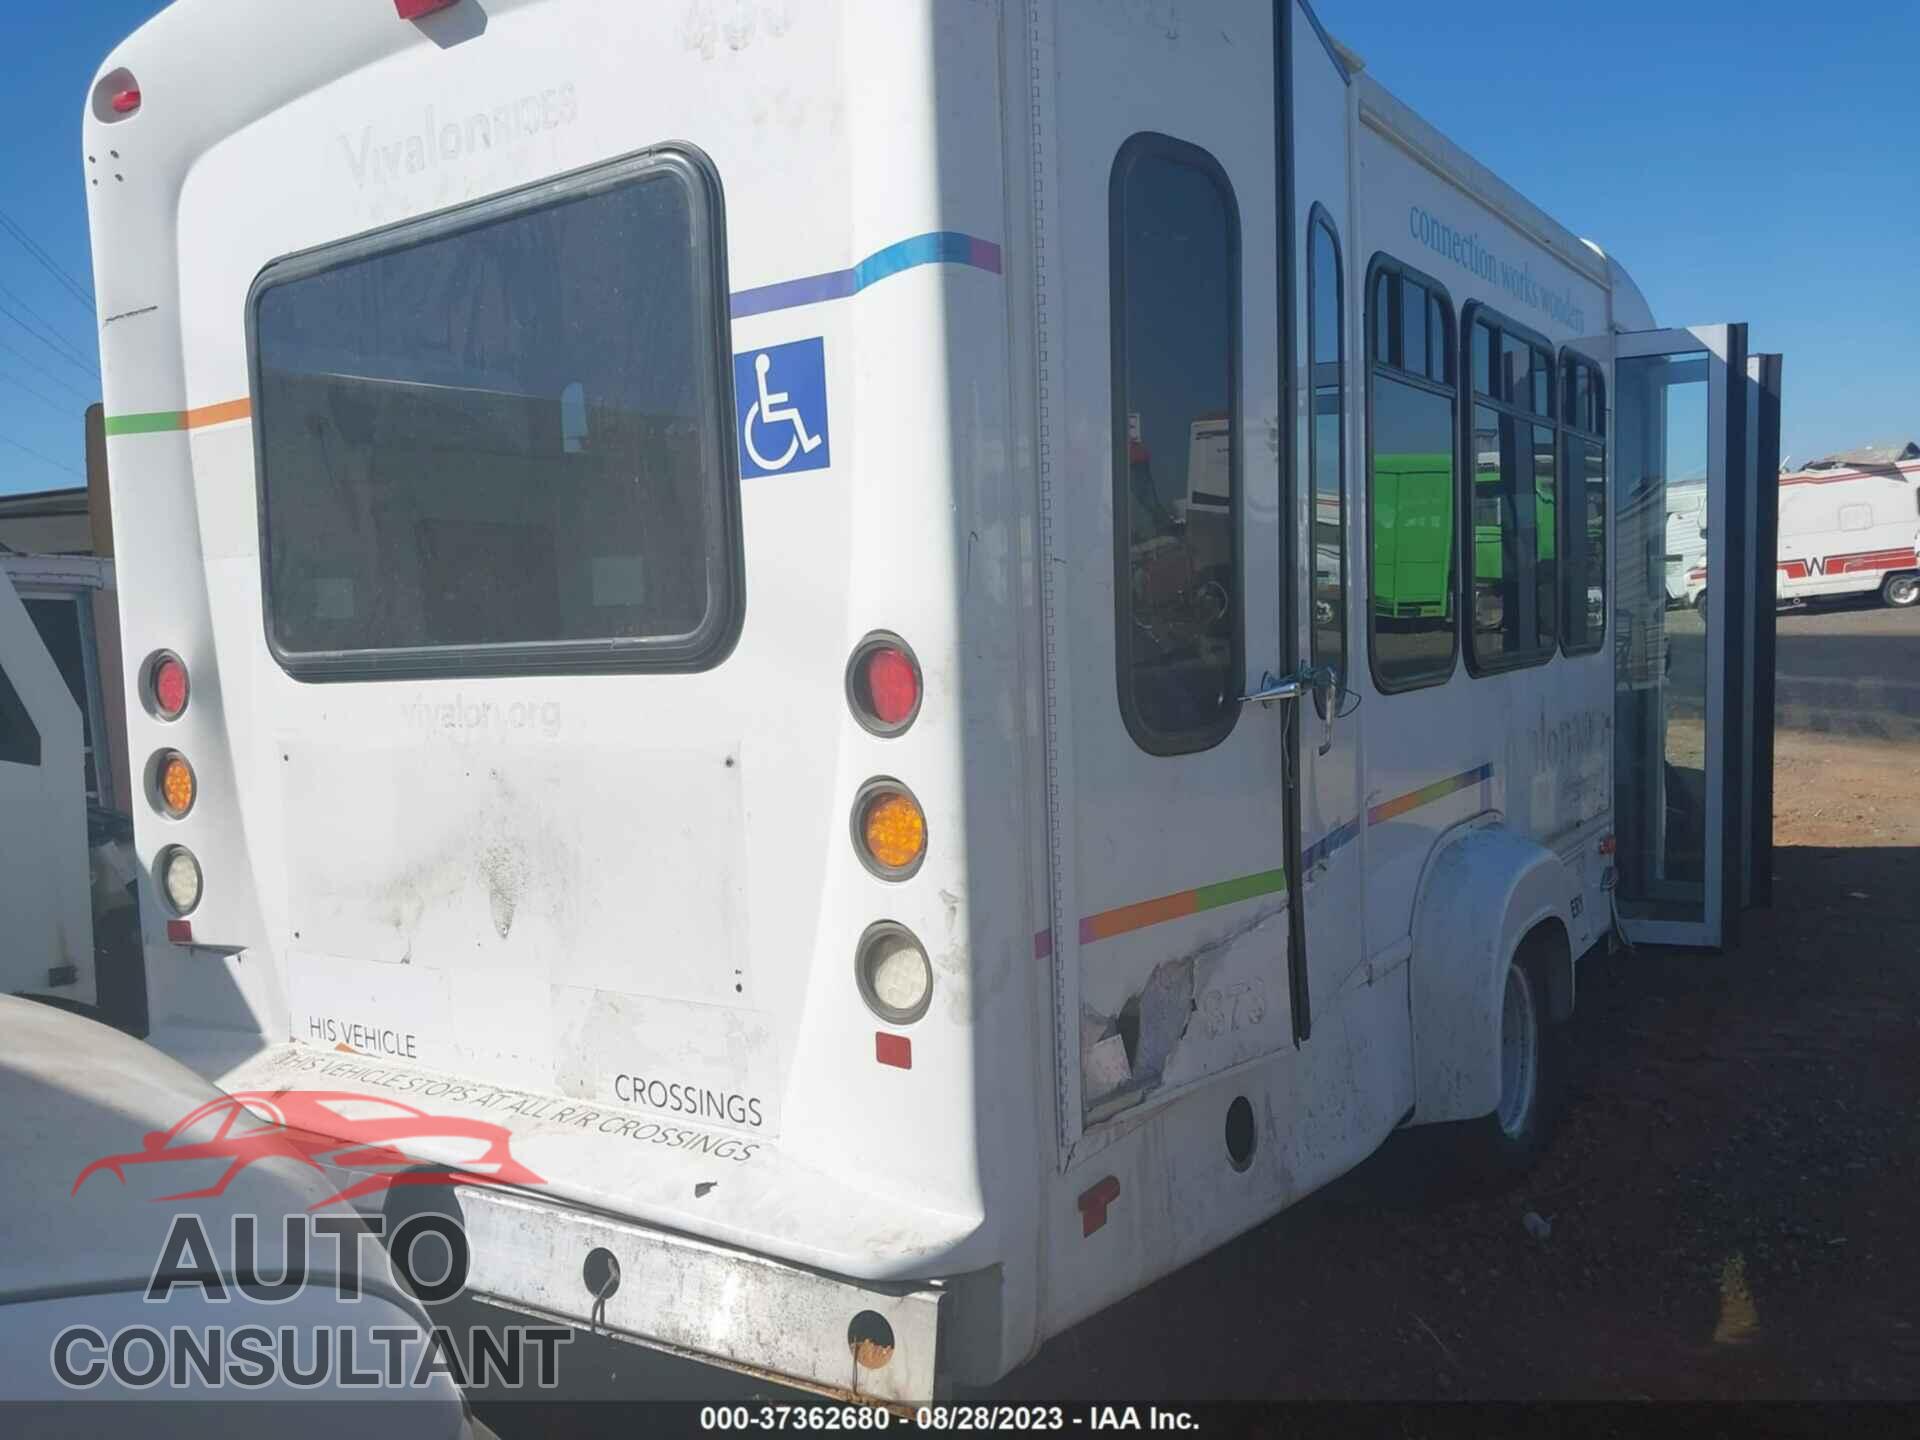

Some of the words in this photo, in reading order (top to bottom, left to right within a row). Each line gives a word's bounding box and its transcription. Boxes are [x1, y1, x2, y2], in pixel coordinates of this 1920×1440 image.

[1410, 205, 1497, 287] connection
[1501, 260, 1538, 308] works
[309, 1015, 337, 1042] HIS
[340, 1021, 417, 1059] VEHICLE
[320, 1059, 399, 1089] VEHICLE
[399, 1076, 478, 1102] STOPS
[475, 1090, 512, 1107] AT
[504, 1096, 550, 1119] ALL
[598, 1116, 761, 1162] CROSSINGS
[615, 1073, 763, 1127] CROSSINGS
